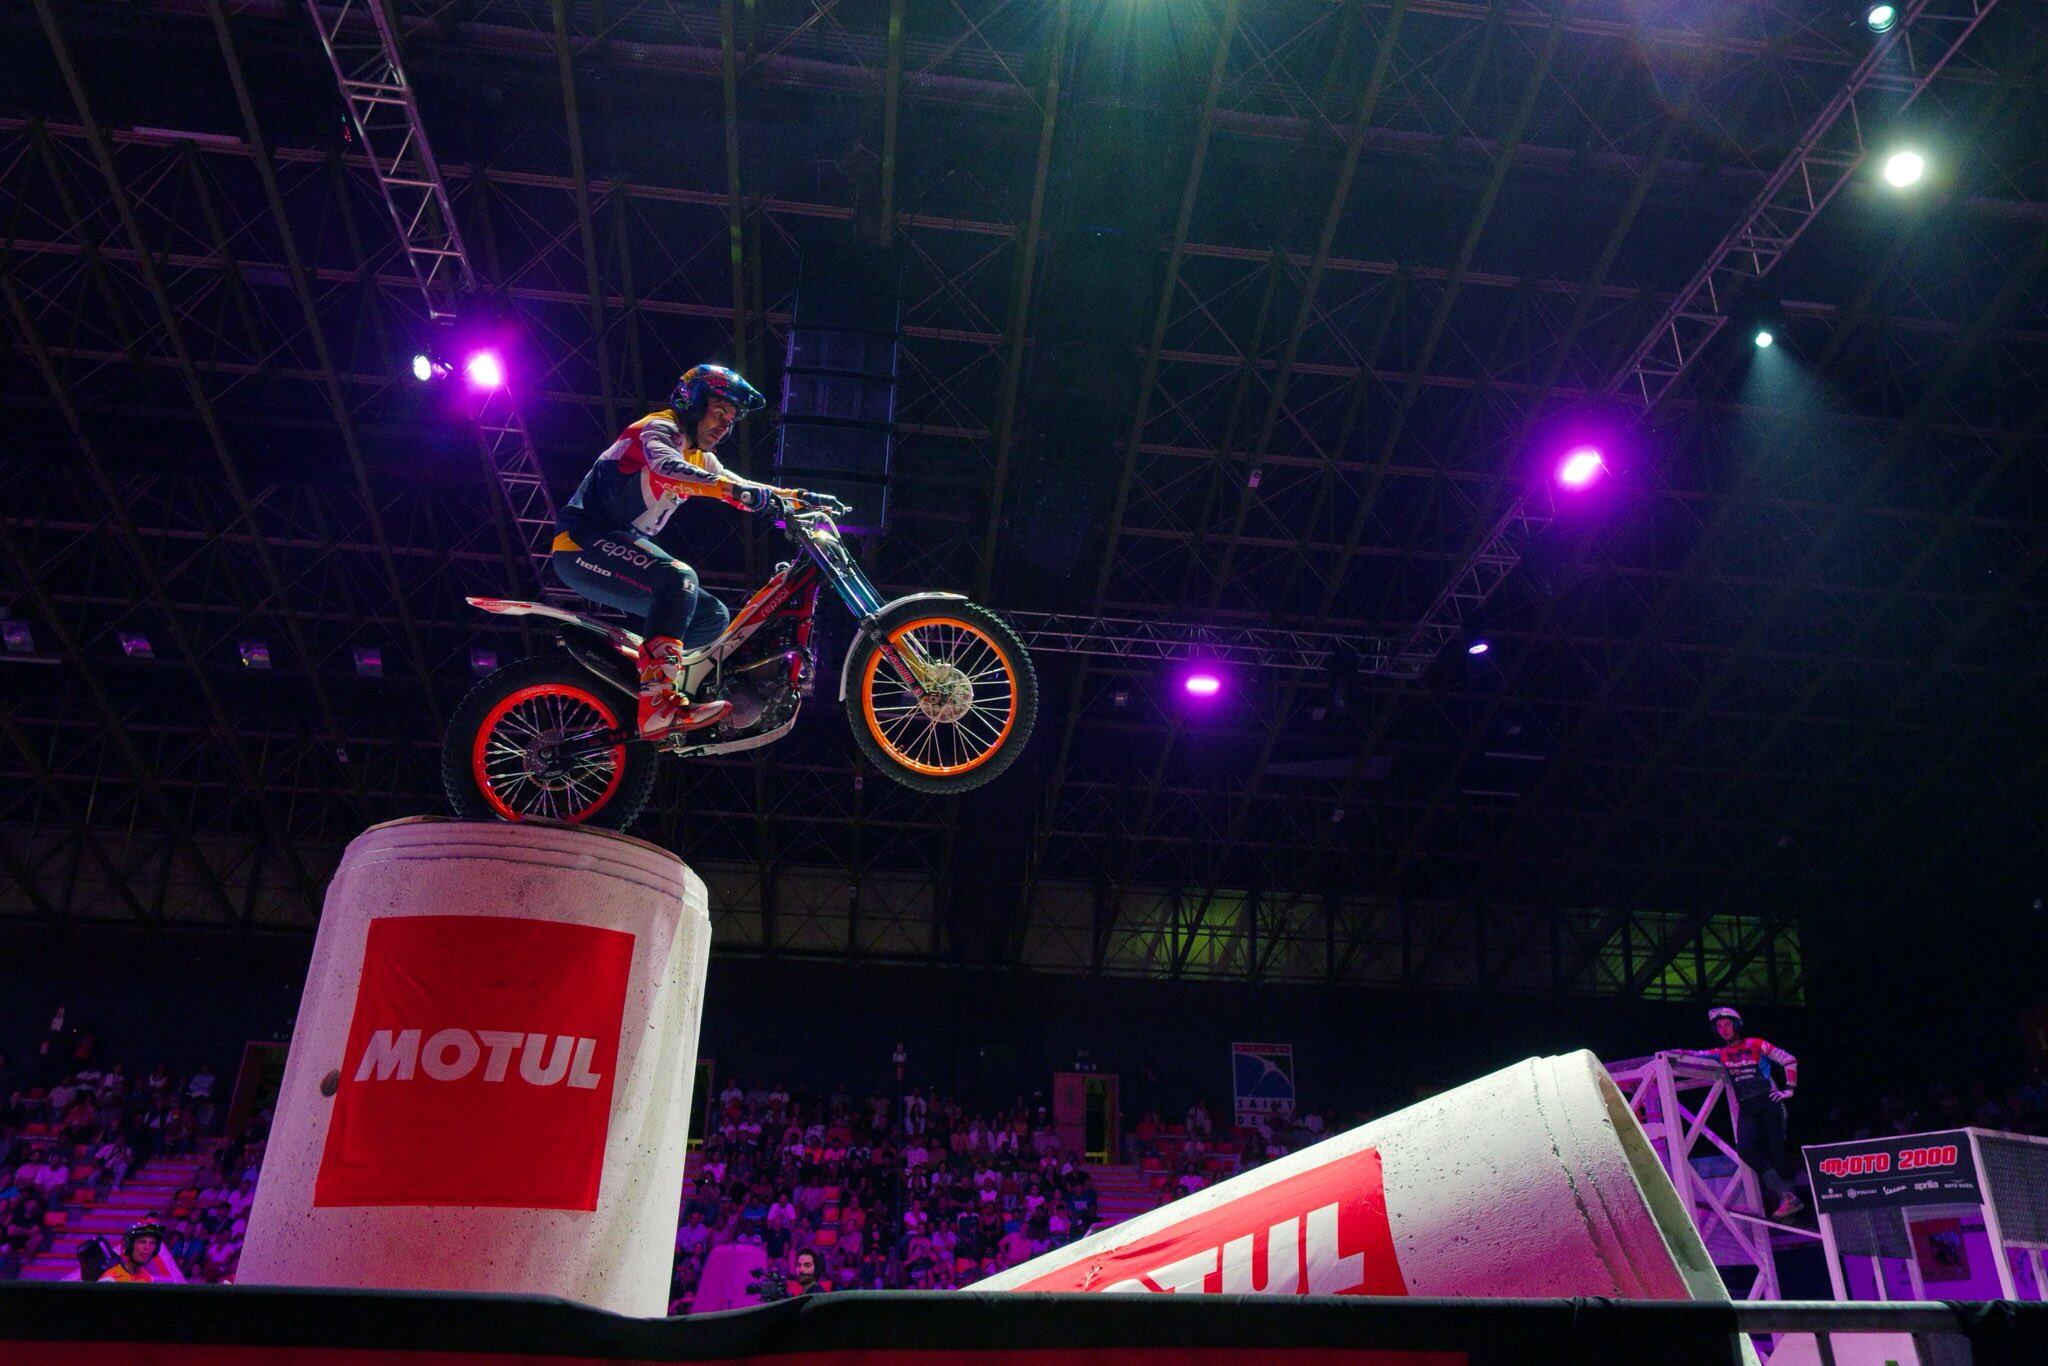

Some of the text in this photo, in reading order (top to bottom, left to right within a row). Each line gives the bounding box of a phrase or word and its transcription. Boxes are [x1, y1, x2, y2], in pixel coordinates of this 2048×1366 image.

[575, 557, 612, 577] hebo
[593, 539, 658, 570] repsol
[761, 587, 790, 618] repsol
[353, 1028, 602, 1090] MOTUL
[1820, 1145, 1958, 1178] MOTO 2000
[1914, 1180, 1940, 1191] aprilia
